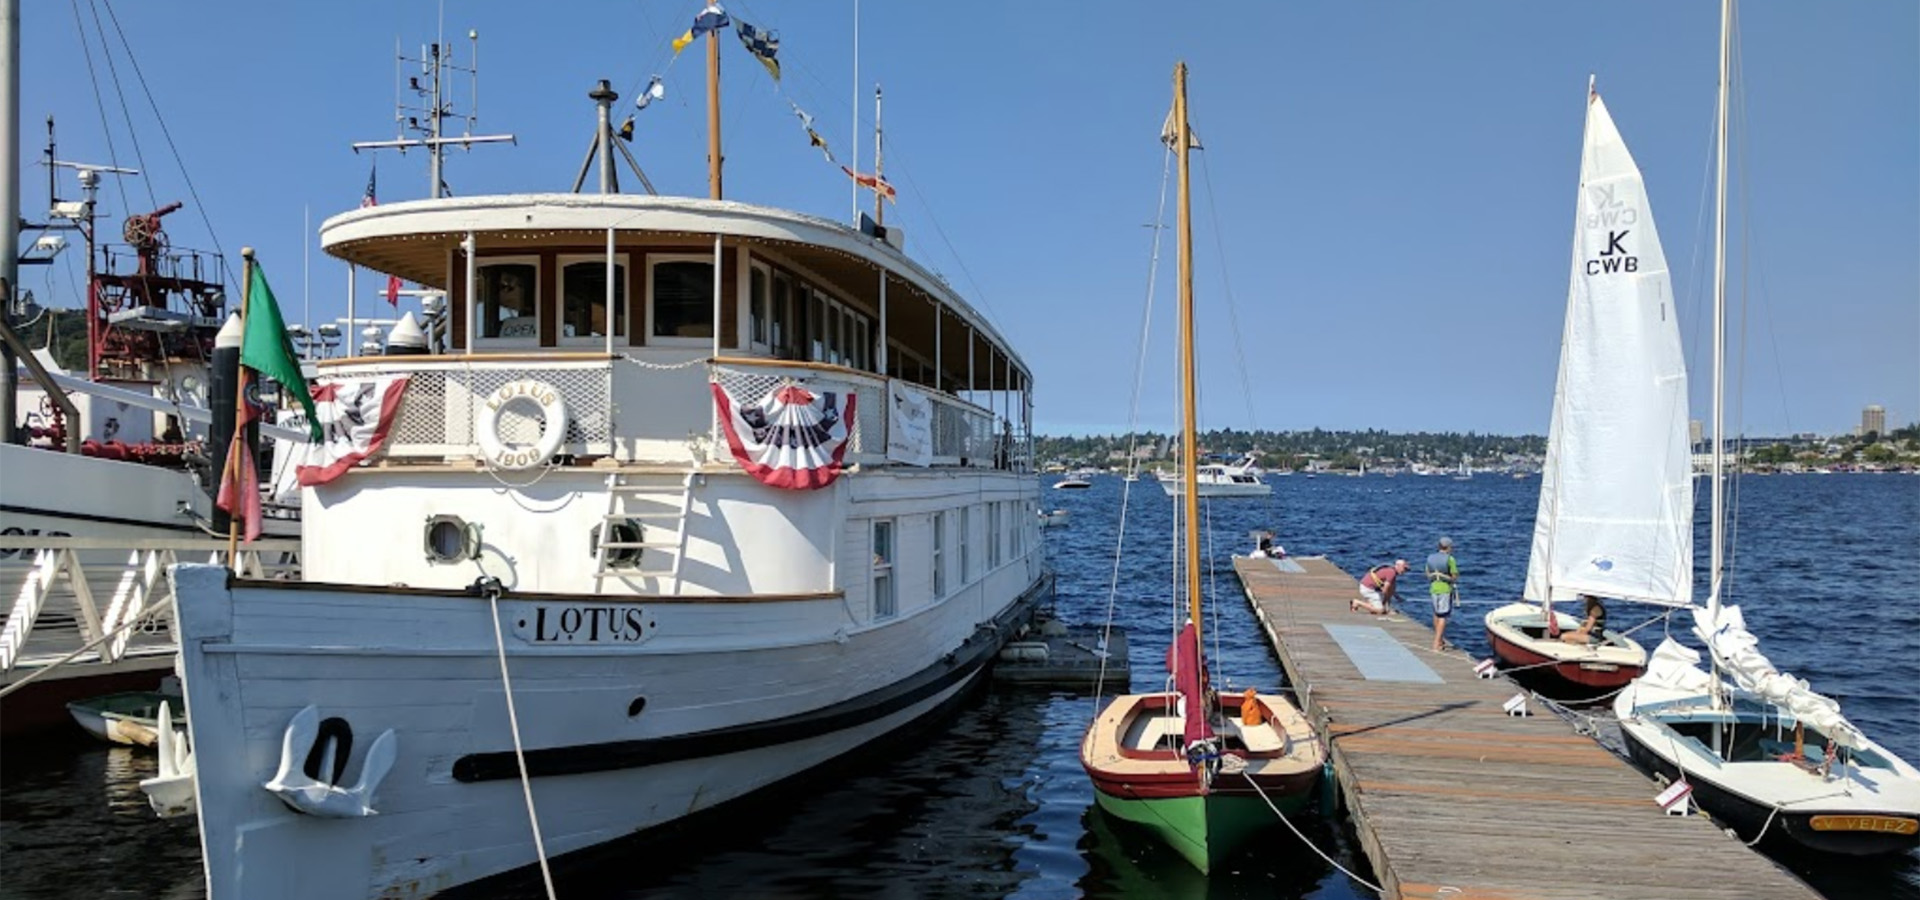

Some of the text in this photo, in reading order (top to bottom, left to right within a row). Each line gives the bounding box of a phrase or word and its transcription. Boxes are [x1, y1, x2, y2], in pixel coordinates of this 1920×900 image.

[1586, 256, 1638, 276] CWB
[486, 383, 556, 412] LOTUS
[495, 448, 541, 467] 1909
[535, 606, 643, 642] LOTUS
[1847, 818, 1907, 833] VELEZ
